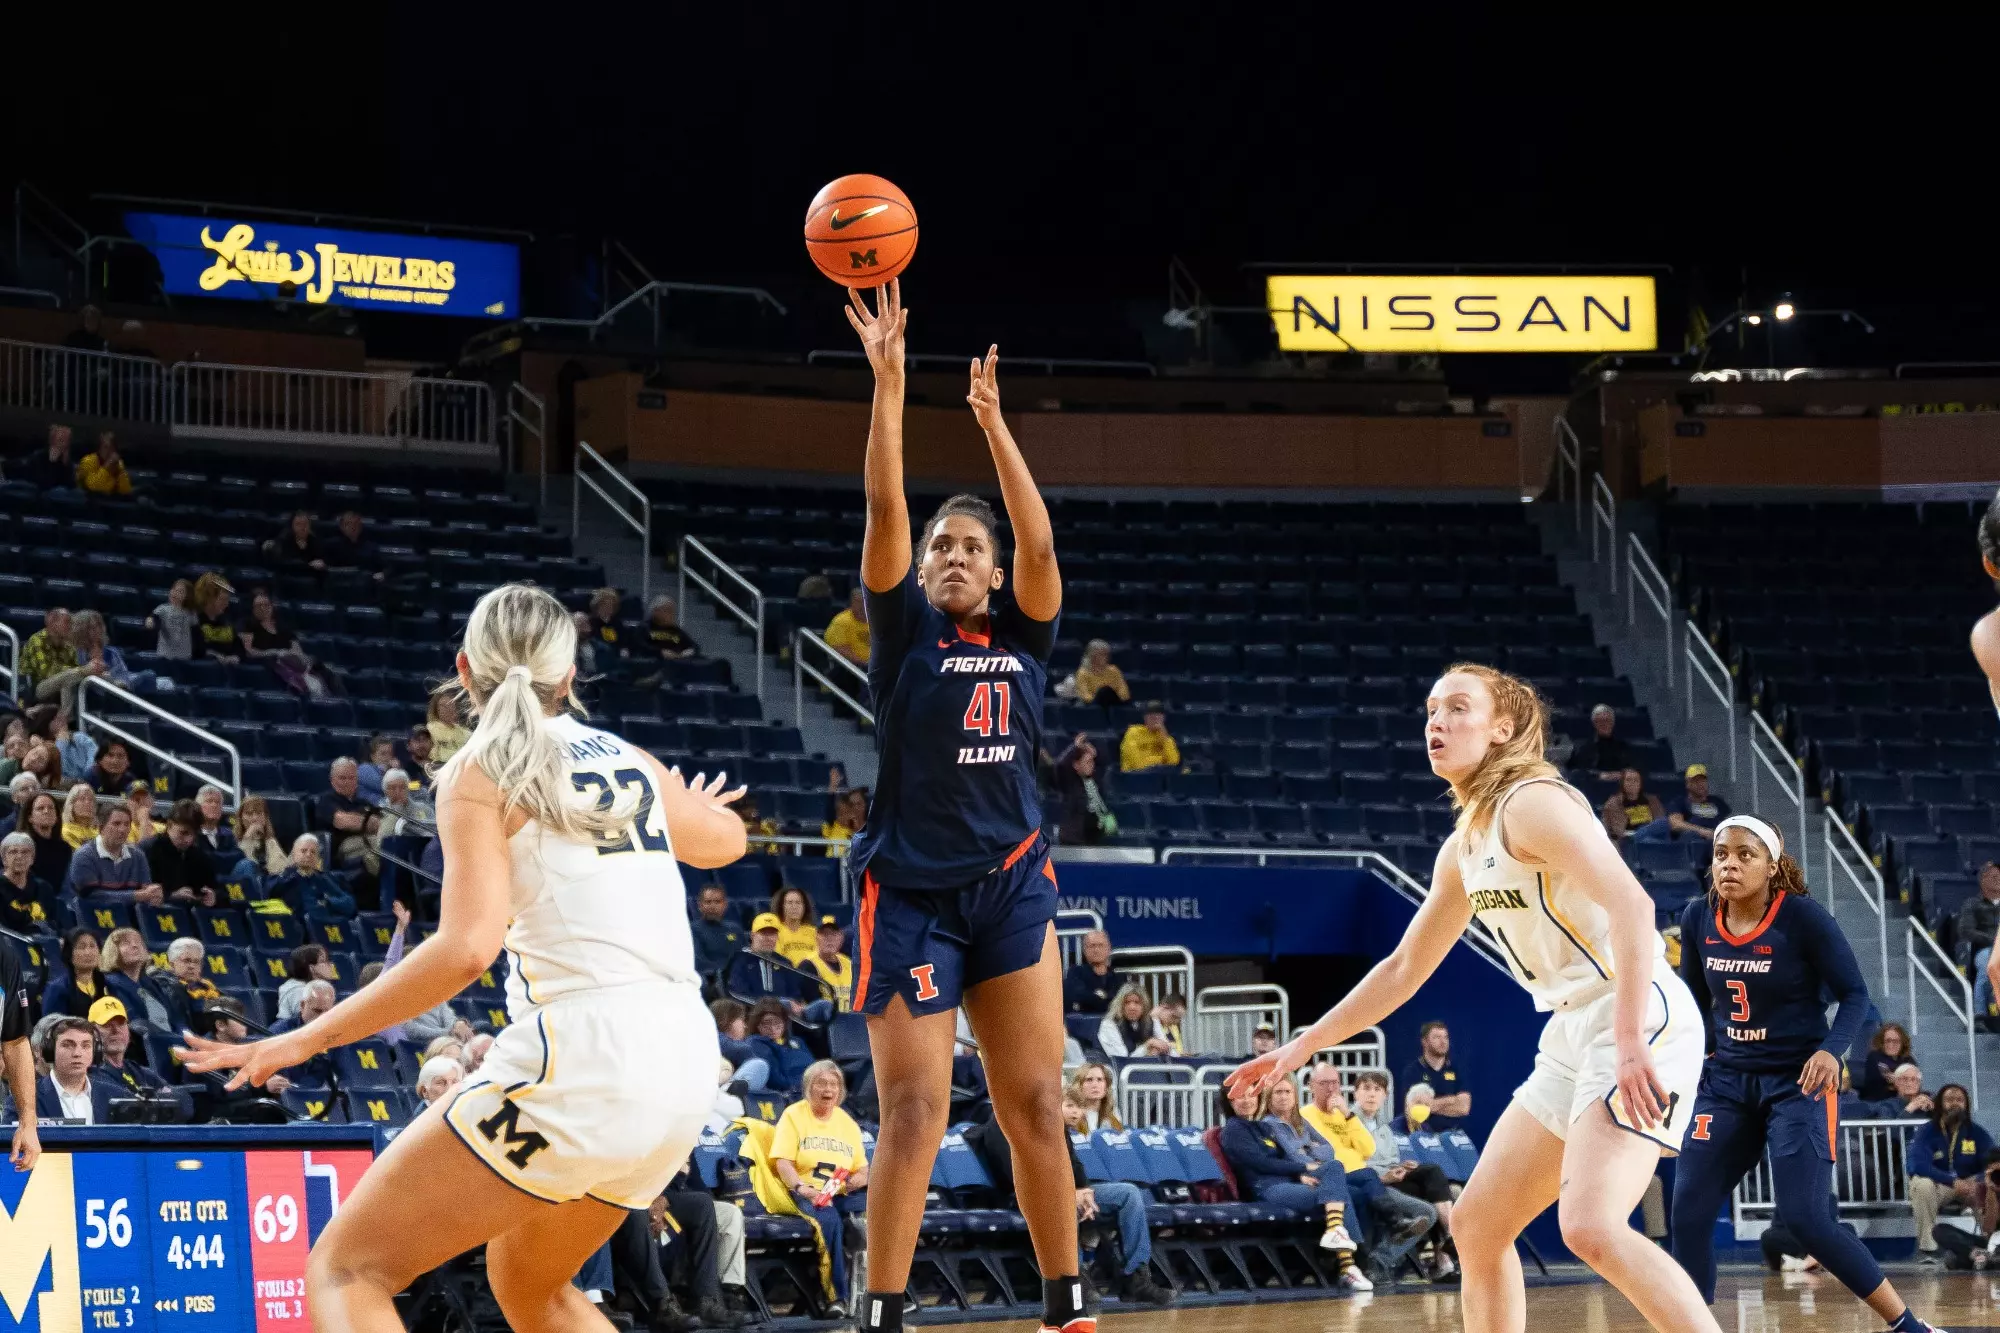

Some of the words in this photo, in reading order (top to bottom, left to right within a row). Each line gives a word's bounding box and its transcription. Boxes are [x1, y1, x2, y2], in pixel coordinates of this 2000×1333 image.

[849, 248, 879, 269] M
[306, 243, 455, 304] JEWELERS
[1293, 296, 1631, 333] NISSAN
[940, 656, 1024, 673] FIGHTIN
[964, 682, 1011, 737] 41
[957, 745, 1016, 764] ILLINI
[1057, 896, 1108, 918] AVIN
[1115, 896, 1203, 919] TUNNEL
[1497, 926, 1537, 982] 1
[1706, 957, 1773, 973] FIGHTING
[1726, 980, 1750, 1021] 3
[1727, 1026, 1767, 1041] ILLINI
[477, 1098, 550, 1171] M
[159, 1201, 191, 1222] 4TH
[196, 1200, 229, 1223] QTR
[254, 1194, 299, 1243] 69
[85, 1198, 133, 1249] 56
[167, 1234, 226, 1270] 4:44
[83, 1288, 126, 1307] FOULS
[131, 1285, 141, 1305] 2
[256, 1280, 295, 1298] FOULS
[296, 1278, 305, 1296] 2
[184, 1296, 216, 1314] POSS
[265, 1302, 290, 1319] TOL
[293, 1300, 303, 1319] 3
[93, 1310, 120, 1329] TOL
[124, 1308, 134, 1328] 3
